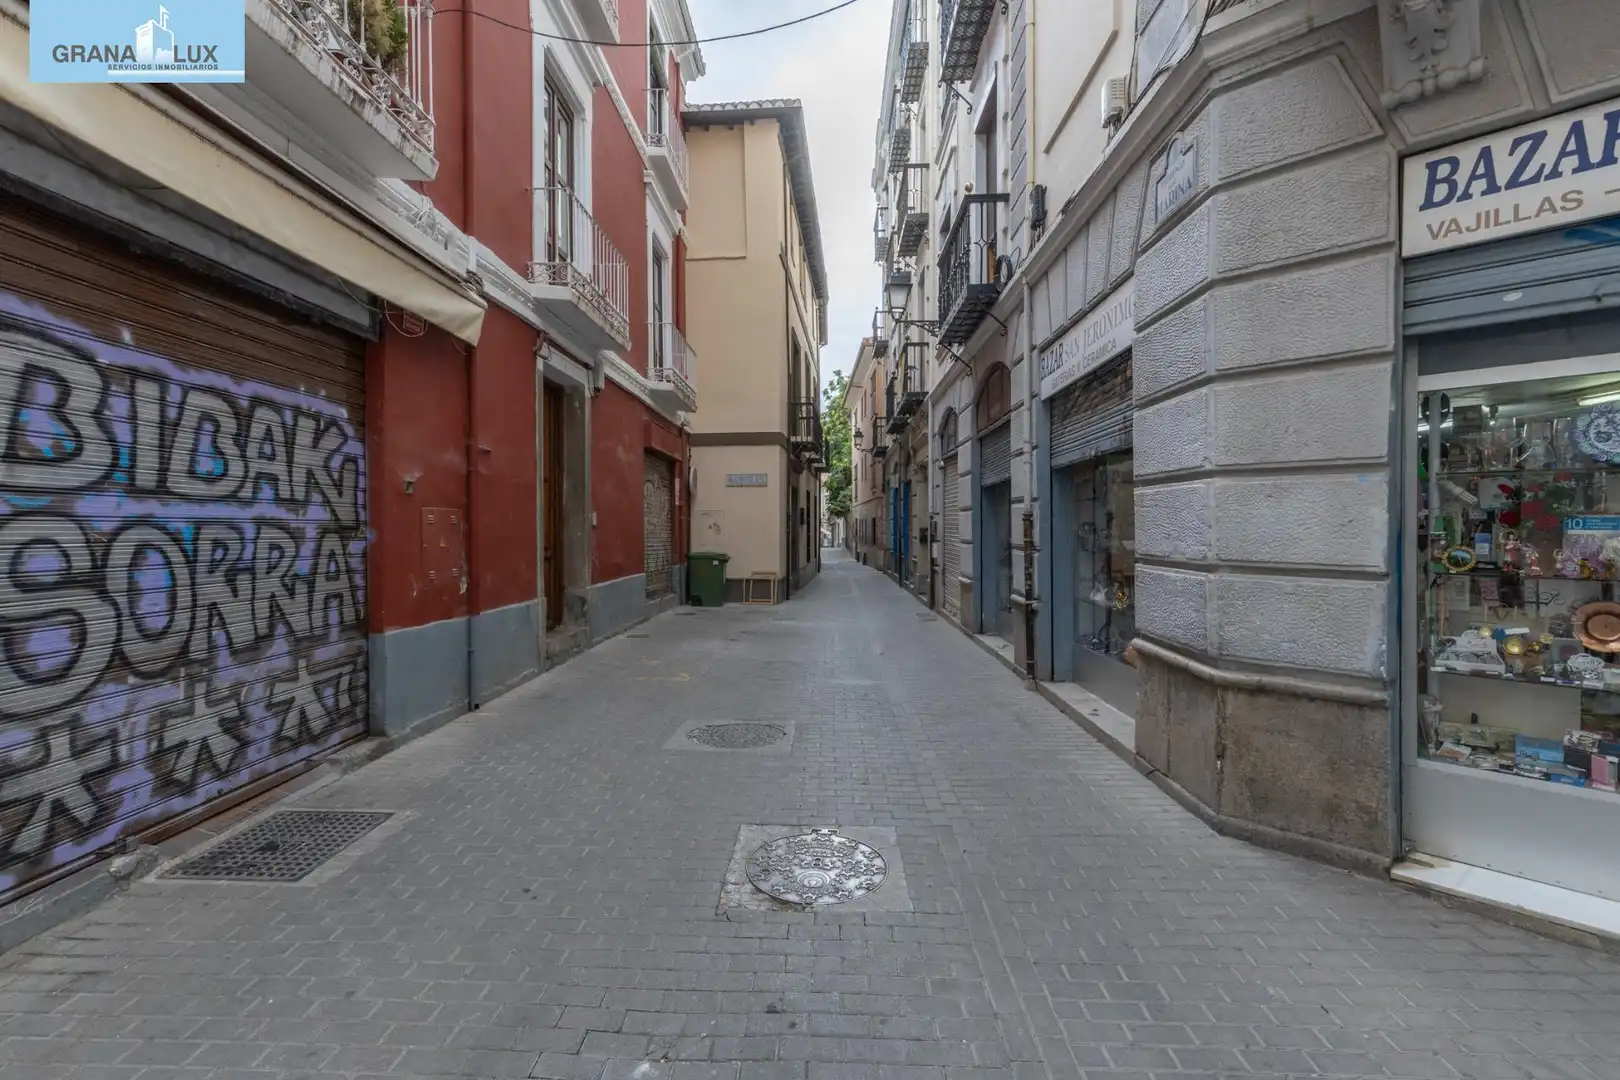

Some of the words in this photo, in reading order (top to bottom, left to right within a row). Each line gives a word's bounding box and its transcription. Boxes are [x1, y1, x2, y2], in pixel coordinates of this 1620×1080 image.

[1426, 189, 1584, 241] VAJILLAS
[1040, 342, 1064, 381] BAZAR
[1063, 335, 1080, 364] SAN
